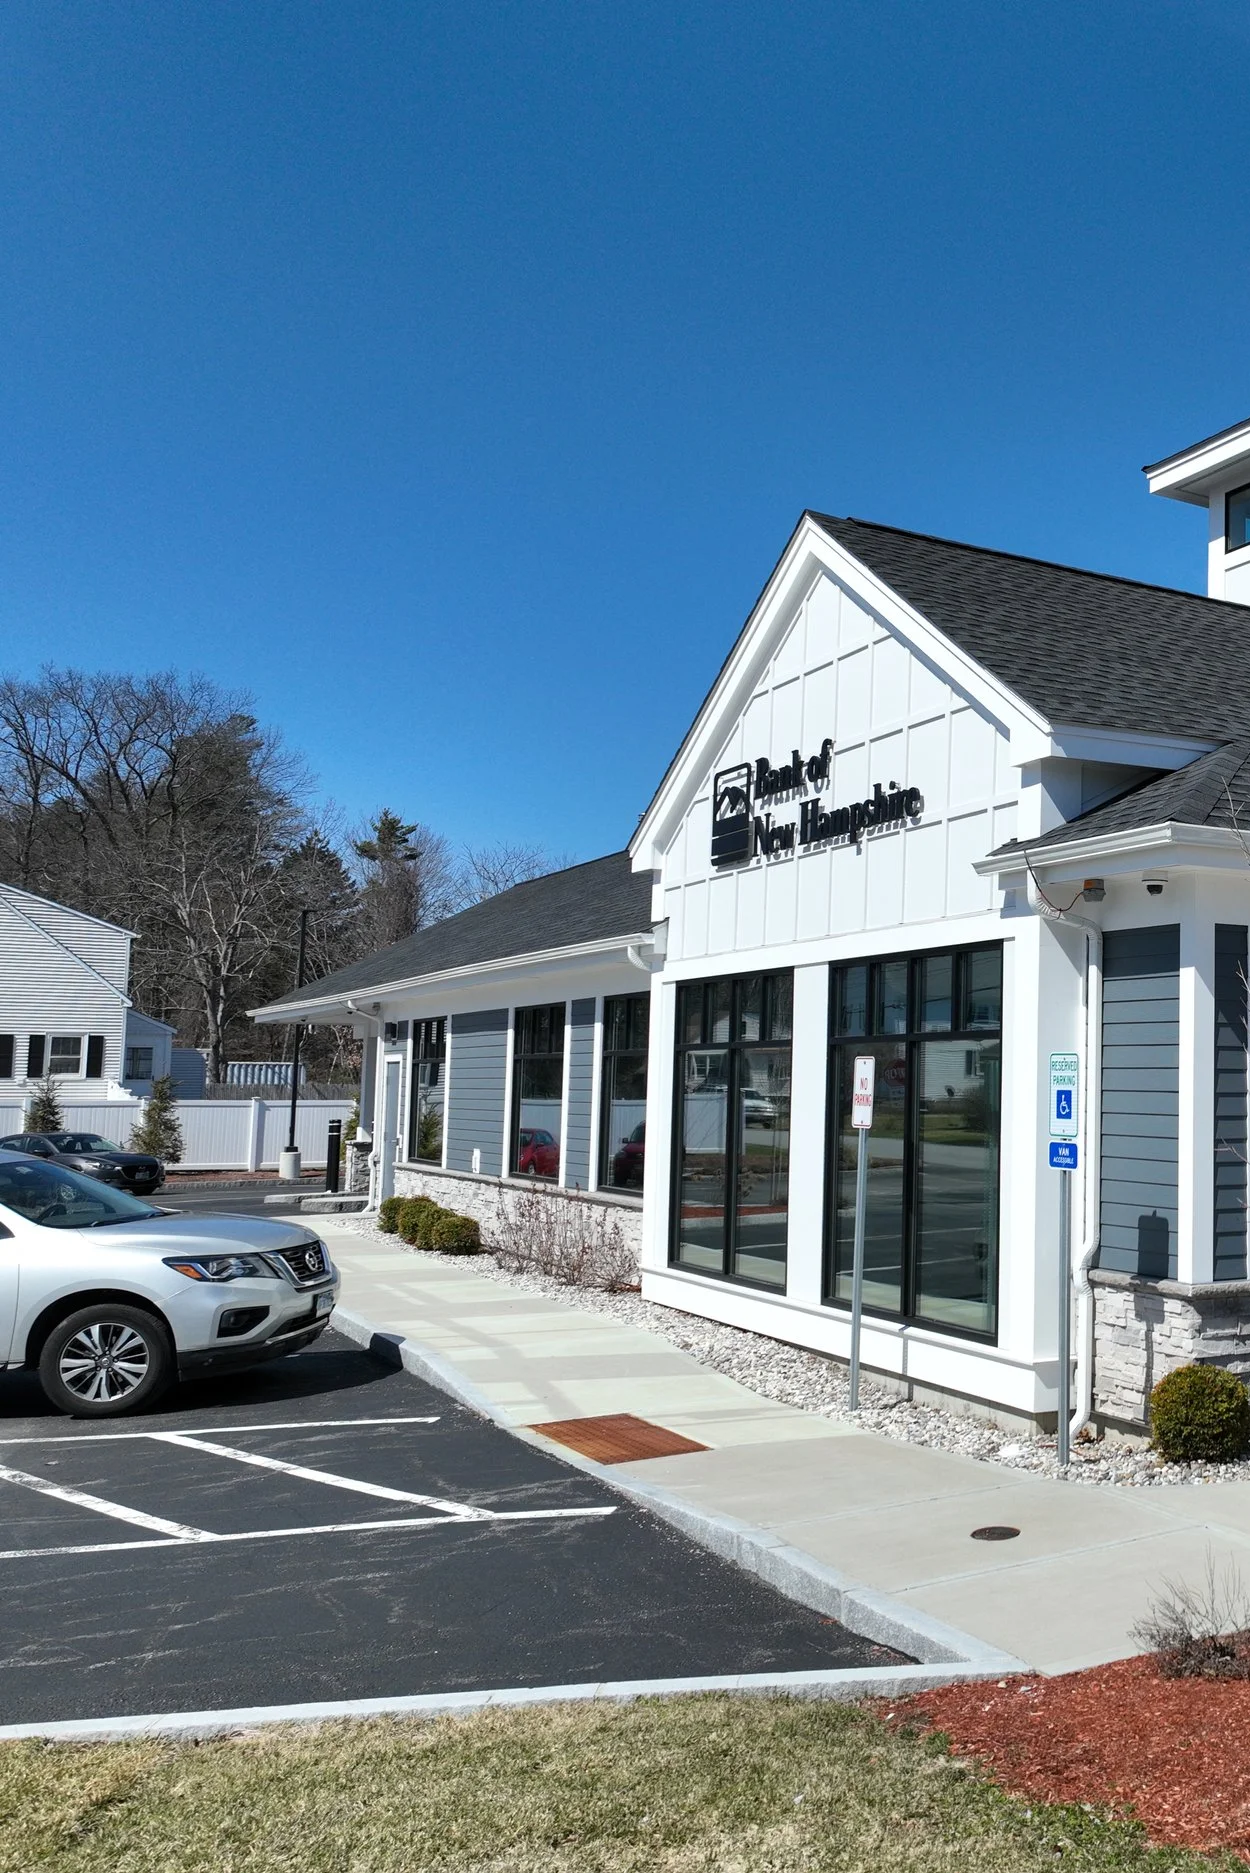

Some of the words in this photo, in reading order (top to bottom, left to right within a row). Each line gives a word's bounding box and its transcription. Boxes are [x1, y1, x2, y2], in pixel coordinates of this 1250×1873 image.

[754, 749, 804, 800] Bank
[807, 738, 835, 783] of
[752, 812, 796, 858] New
[798, 780, 922, 845] Hampshire
[1051, 1061, 1077, 1071] RESERVED
[860, 1077, 869, 1091] NO
[1053, 1075, 1076, 1086] PARKING
[853, 1093, 872, 1107] PARKING
[1058, 1147, 1070, 1156] VAN
[1053, 1156, 1074, 1165] ACCESSIBLE
